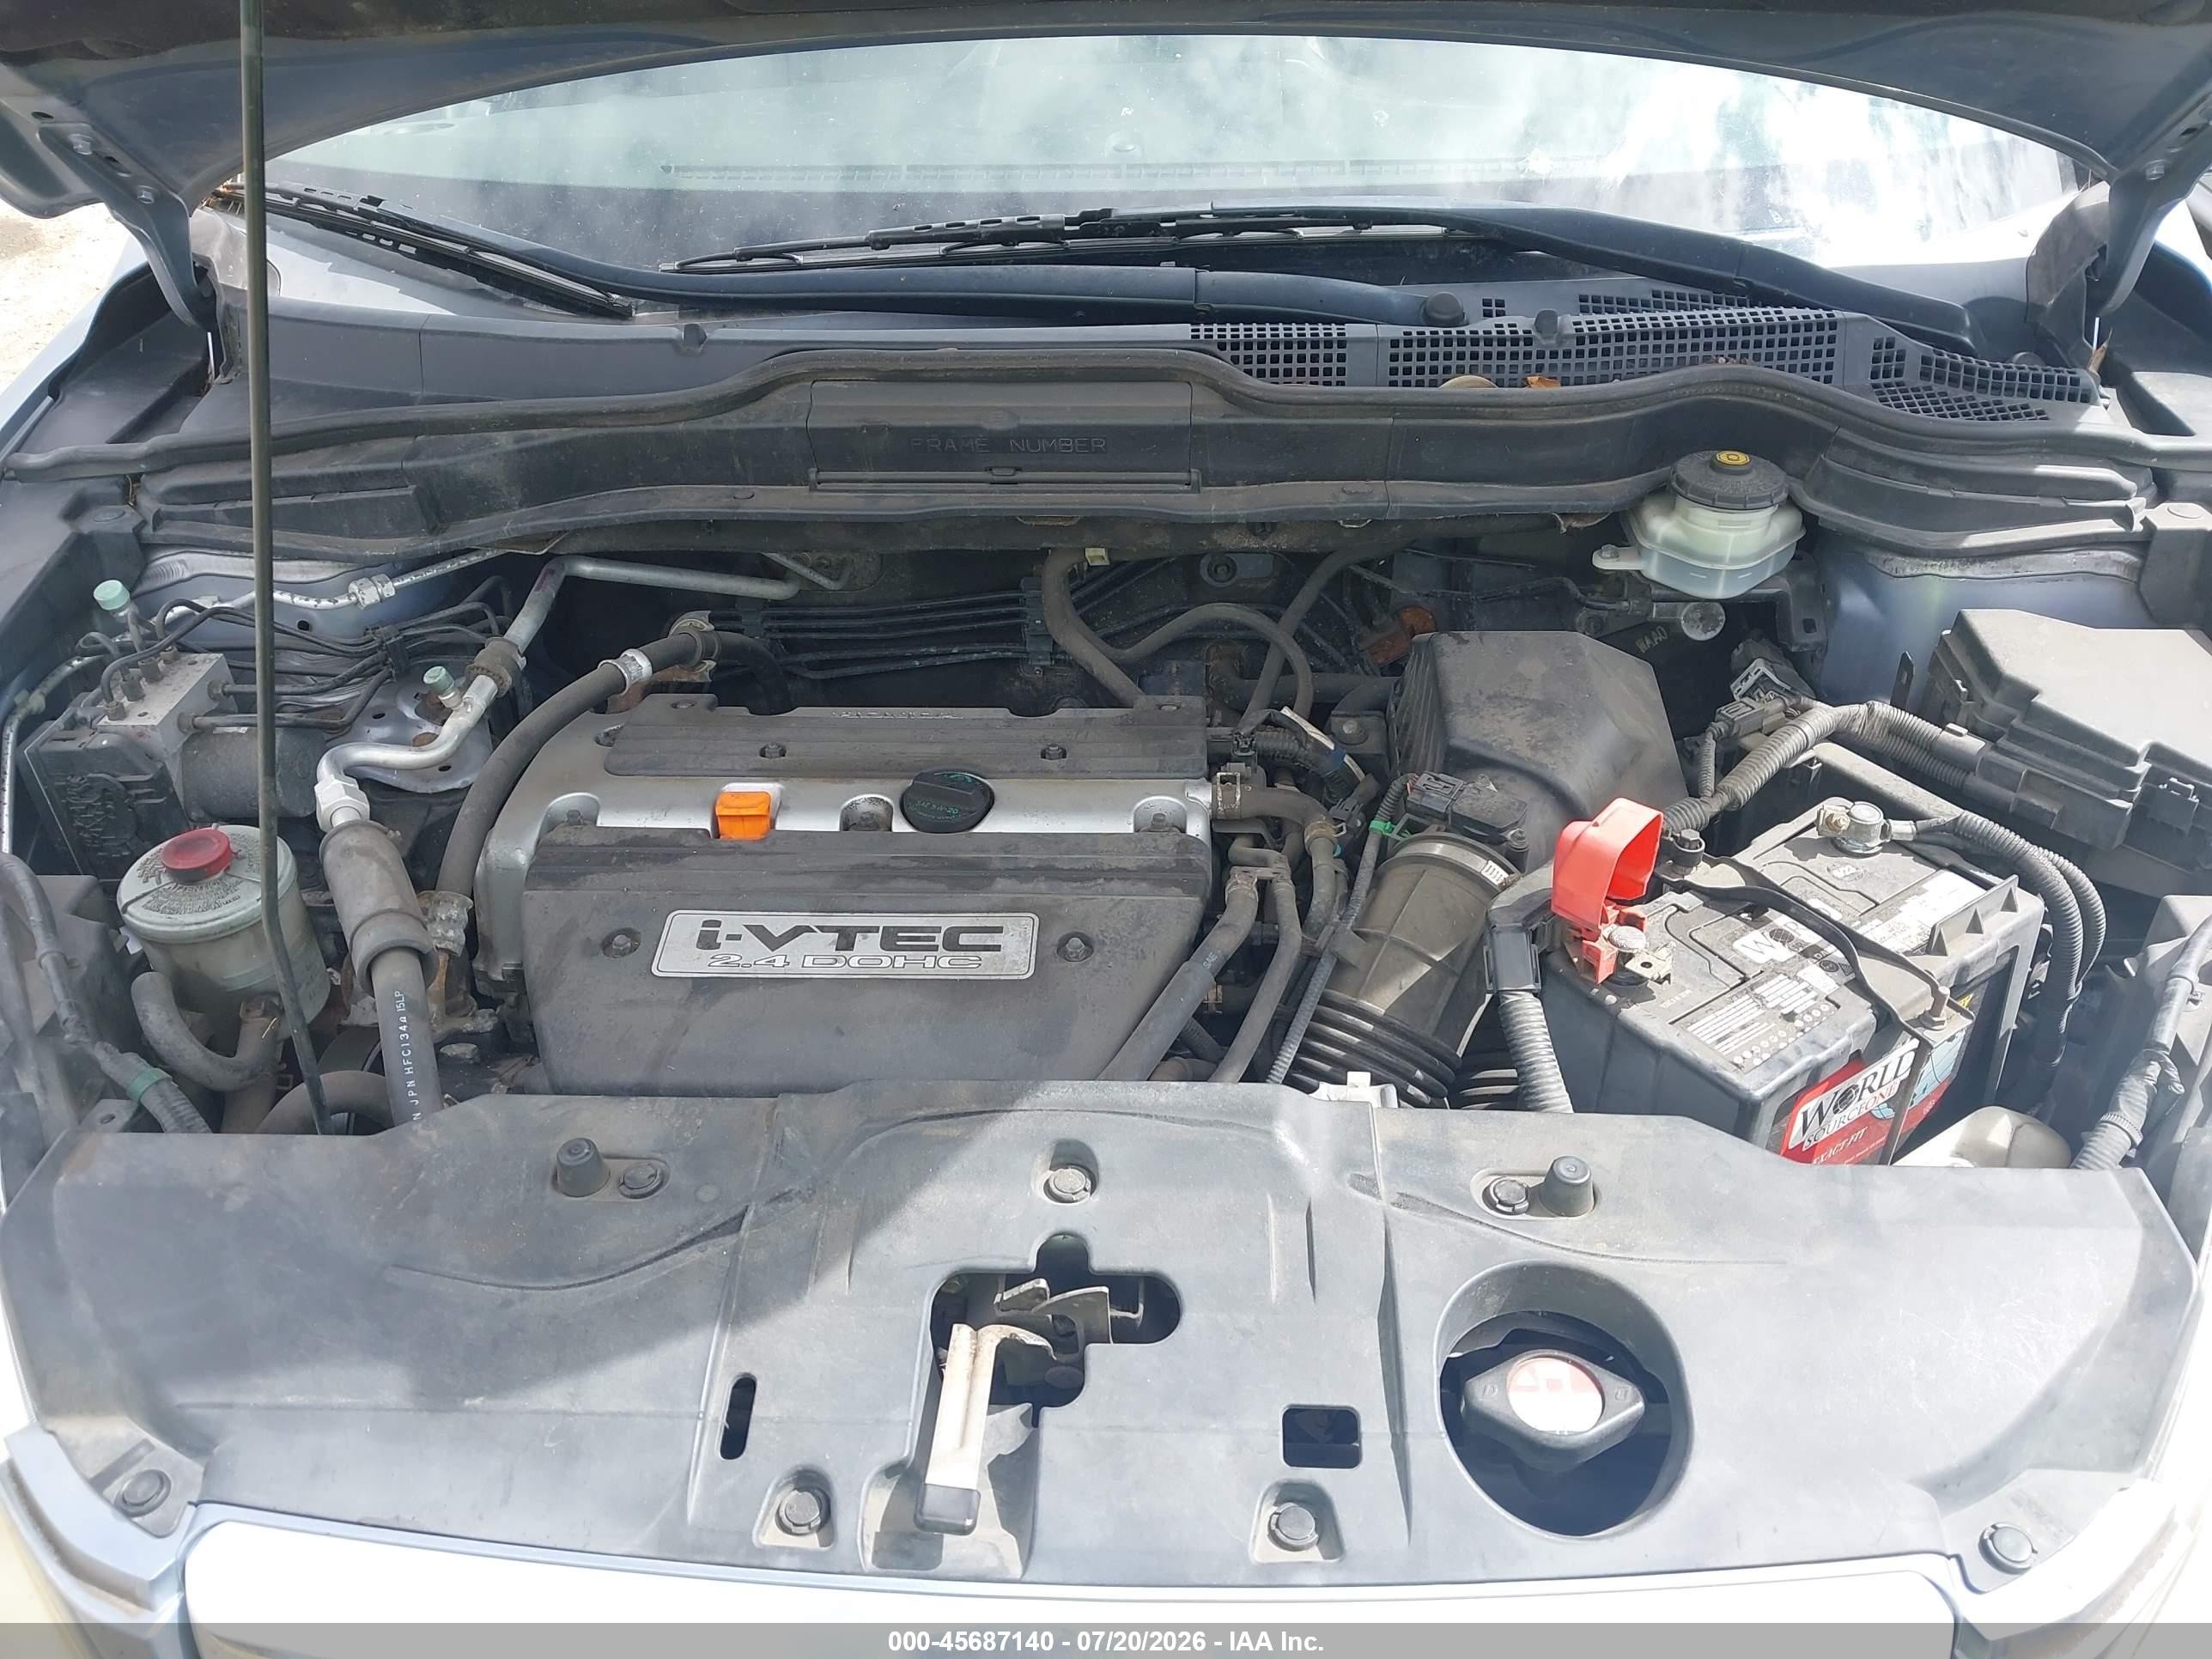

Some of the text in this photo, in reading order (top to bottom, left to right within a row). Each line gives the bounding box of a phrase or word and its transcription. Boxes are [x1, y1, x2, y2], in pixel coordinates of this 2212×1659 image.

[911, 437, 1107, 453] FRAME NUMBER
[696, 919, 1004, 952] i-VTEC
[708, 954, 982, 969] 2.4 DOHC
[406, 1079, 420, 1106] JPN
[1801, 1050, 1915, 1138] WORLD
